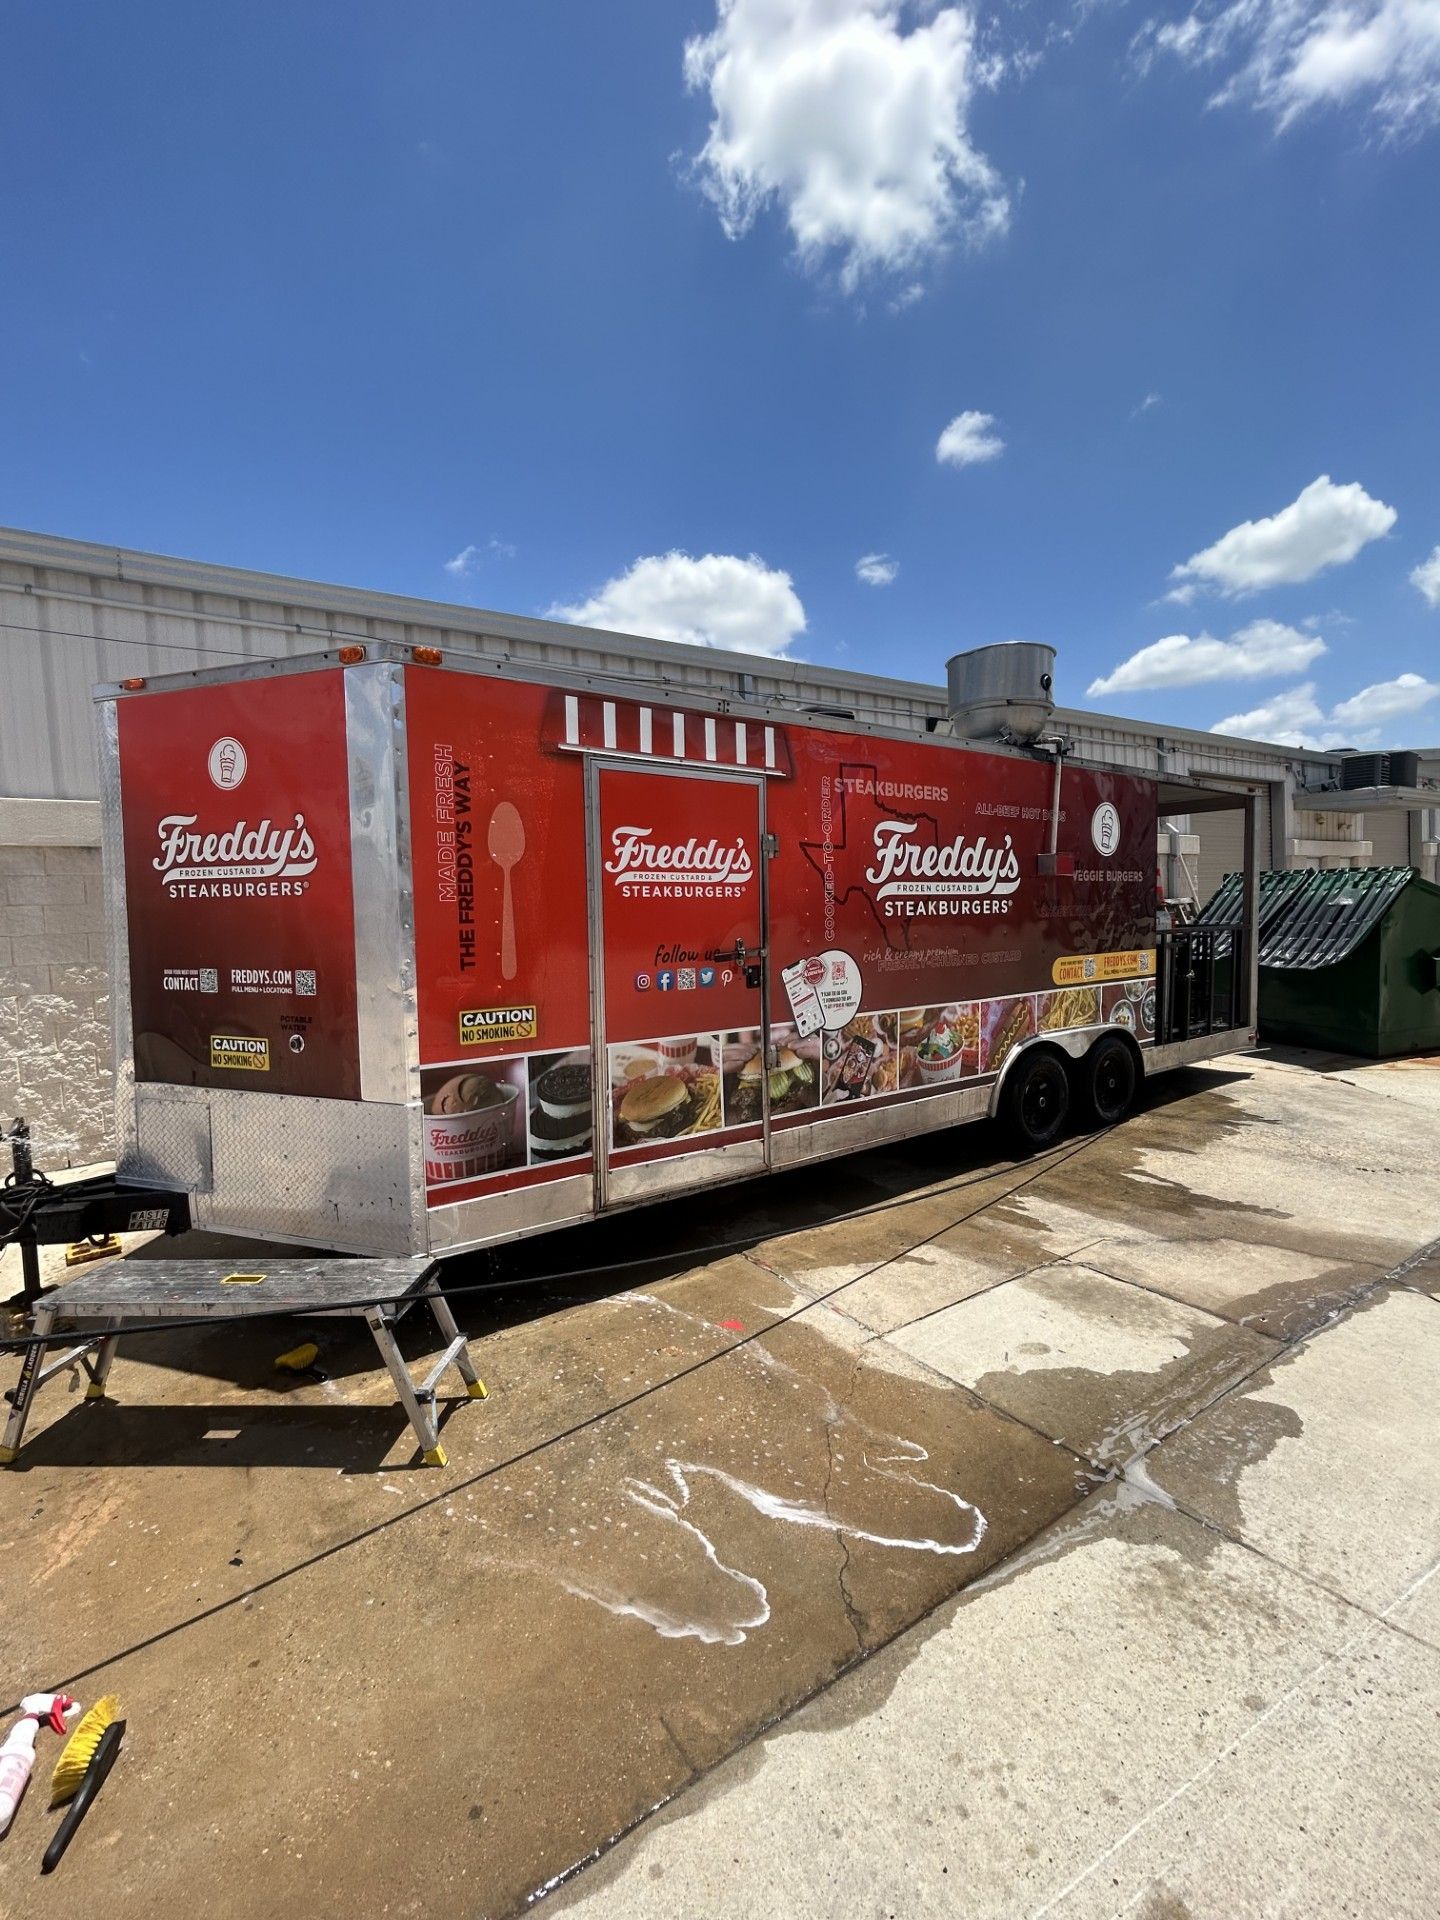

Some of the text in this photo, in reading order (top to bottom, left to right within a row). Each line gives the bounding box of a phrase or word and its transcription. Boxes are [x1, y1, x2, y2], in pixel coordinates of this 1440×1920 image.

[834, 778, 949, 801] STEAKBURGERS
[974, 802, 1020, 818] ALL-BEEF
[1021, 807, 1041, 820] HOT
[434, 743, 457, 902] MADE FRESH
[153, 813, 317, 877] Freddy's
[605, 826, 753, 878] Freddy's
[821, 775, 835, 942] COOKED-TO-ORDER
[866, 820, 1020, 888] Freddy's
[179, 867, 265, 877] FROZEN CUSTARD &
[453, 760, 475, 971] THE FREDDY'S WAY
[1073, 869, 1143, 882] VEGGIE BURGERS
[897, 884, 932, 892] FROZEN
[935, 884, 973, 892] CUSTARD
[655, 944, 699, 967] follow
[863, 947, 882, 961] rich
[884, 946, 893, 960] &
[894, 949, 925, 962] creamy
[231, 969, 292, 985] FREDDYS.COM
[1060, 967, 1083, 981] CONTACT
[164, 976, 199, 990] CONTACT
[463, 1009, 533, 1026] CAUTION
[462, 1026, 515, 1041] NO SMOKING
[213, 1039, 266, 1053] CAUTION
[212, 1054, 252, 1066] NO SMOKING
[131, 1210, 168, 1220] WASTE
[130, 1220, 166, 1229] WATER
